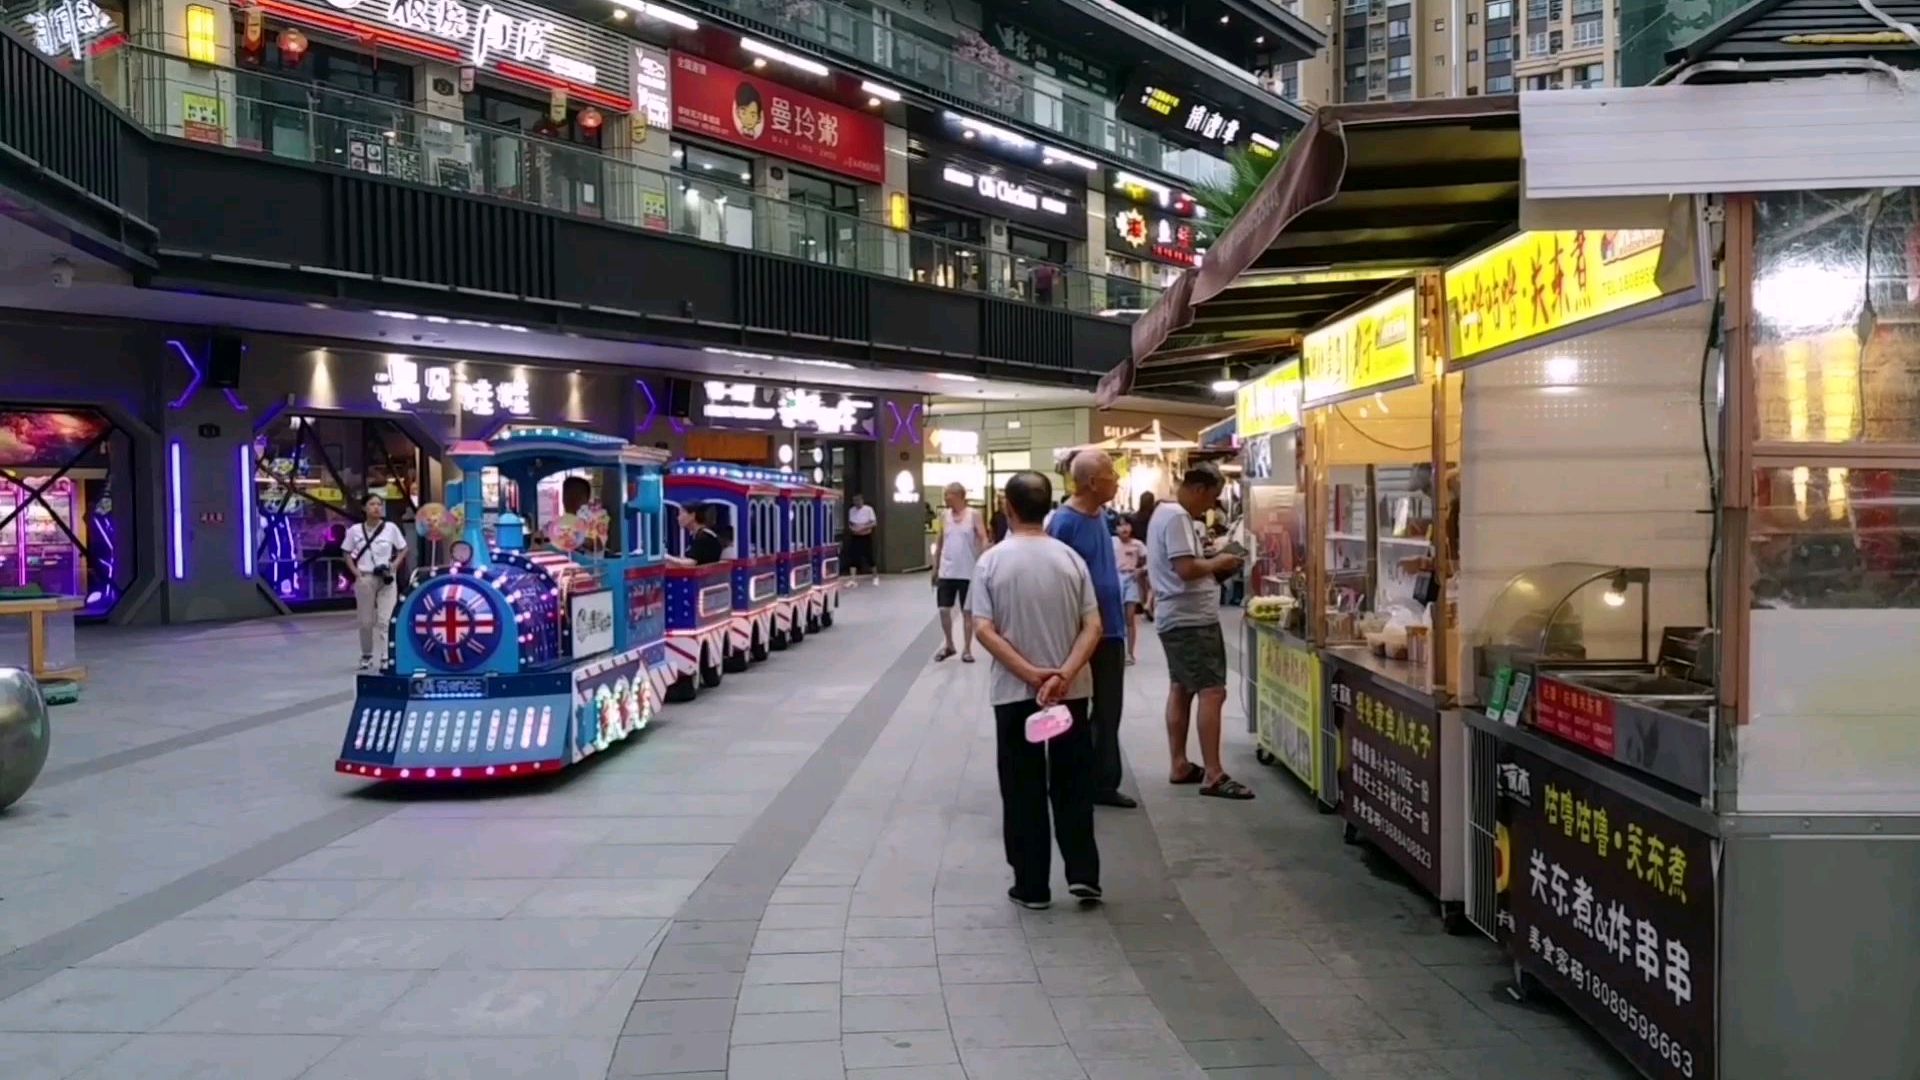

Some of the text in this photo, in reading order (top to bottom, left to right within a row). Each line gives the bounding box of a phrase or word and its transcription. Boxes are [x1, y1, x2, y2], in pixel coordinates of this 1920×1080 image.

[770, 97, 838, 147] 曼玲粥
[1529, 848, 1693, 1007] 关东煮&炸串串
